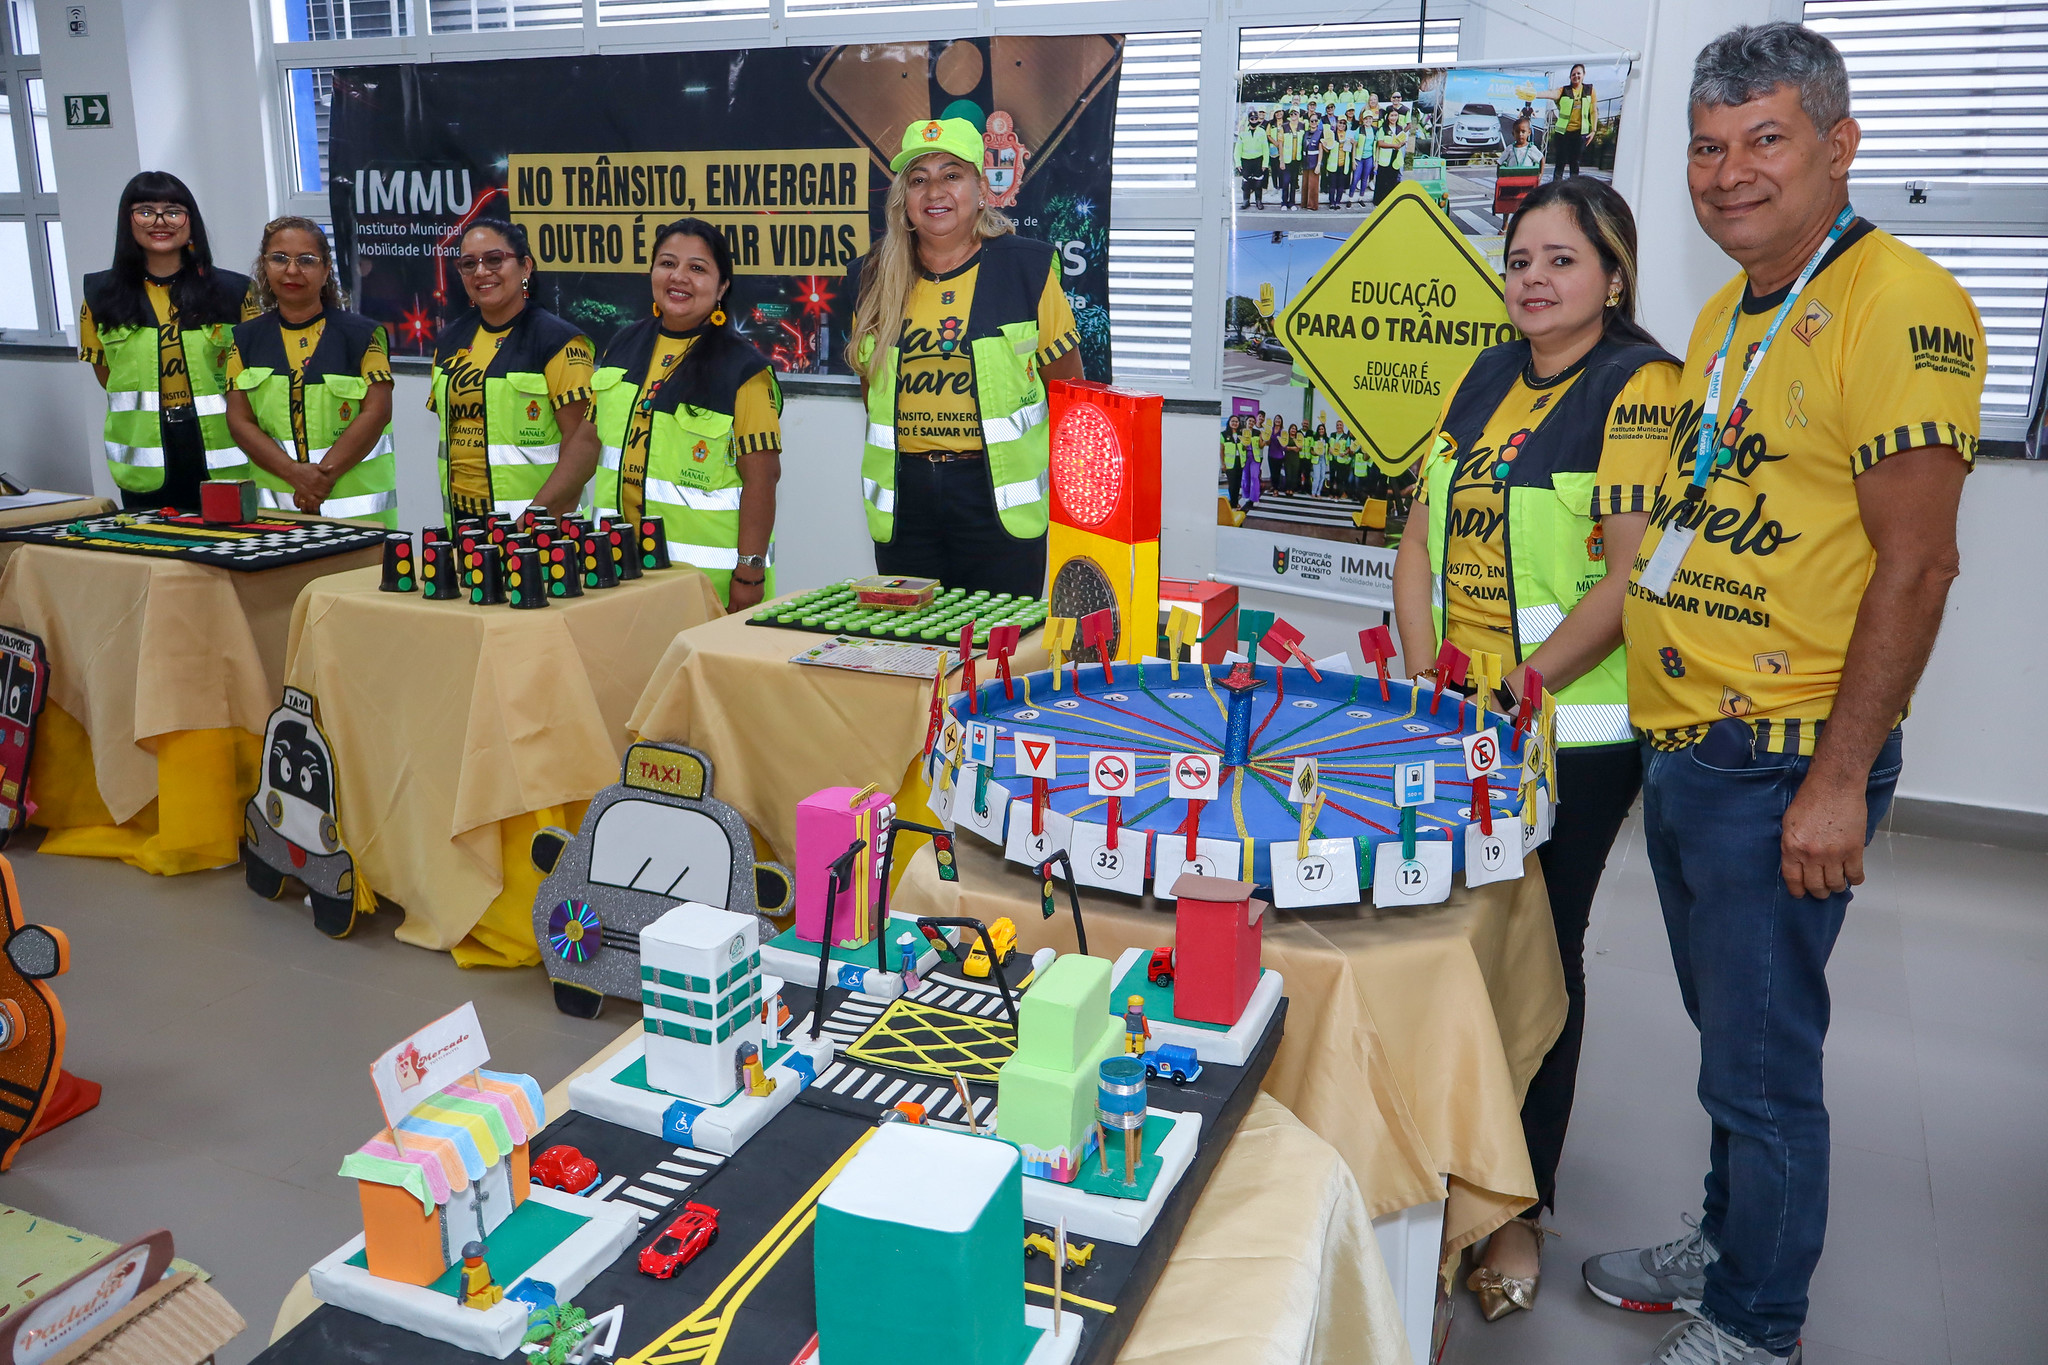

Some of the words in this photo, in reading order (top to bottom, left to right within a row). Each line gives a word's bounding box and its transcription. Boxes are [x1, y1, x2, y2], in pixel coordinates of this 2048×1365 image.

[518, 166, 553, 206] NO
[562, 155, 696, 211] TRÂNSITO,
[706, 162, 857, 206] ENXERGAR
[355, 168, 472, 215] IMMU
[1024, 216, 1038, 227] de
[355, 221, 407, 235] Instituto
[410, 221, 463, 239] Municipal
[539, 223, 623, 264] OUTRO
[633, 214, 648, 265] É
[770, 224, 858, 267] VIDAS
[357, 242, 420, 257] Mobilidade
[1351, 278, 1457, 312] EDUCAÇÃO
[1296, 312, 1356, 339] PARA
[1361, 316, 1380, 340] O
[1385, 311, 1516, 347] TRÂNSITO
[1908, 325, 1974, 362] IMMU
[1366, 360, 1417, 379] EDUCAR
[1421, 361, 1429, 380] É
[1353, 375, 1399, 393] SALVAR
[1402, 378, 1441, 396] VIDAS
[1709, 371, 1722, 400] IMMU
[898, 410, 934, 422] ÂNSITO,
[920, 427, 961, 437] SALVAR
[1637, 426, 1668, 434] Municipal
[1645, 433, 1669, 441] Urbana
[681, 468, 711, 484] MANAUS
[1291, 555, 1332, 568] EDUCAÇÃO
[1292, 548, 1322, 559] Programa
[1300, 565, 1332, 575] TRÂNSITO
[1340, 576, 1373, 587] Mobilidade
[1462, 585, 1508, 601] SALVA
[1704, 600, 1771, 628] VIDAS!
[289, 694, 308, 710] TAXI
[639, 762, 681, 784] TAXI
[1035, 838, 1044, 852] 4
[1485, 845, 1500, 860] 19
[1097, 852, 1119, 871] 32
[1303, 864, 1325, 880] 27
[1402, 869, 1422, 885] 12
[418, 1034, 469, 1068] Mercado
